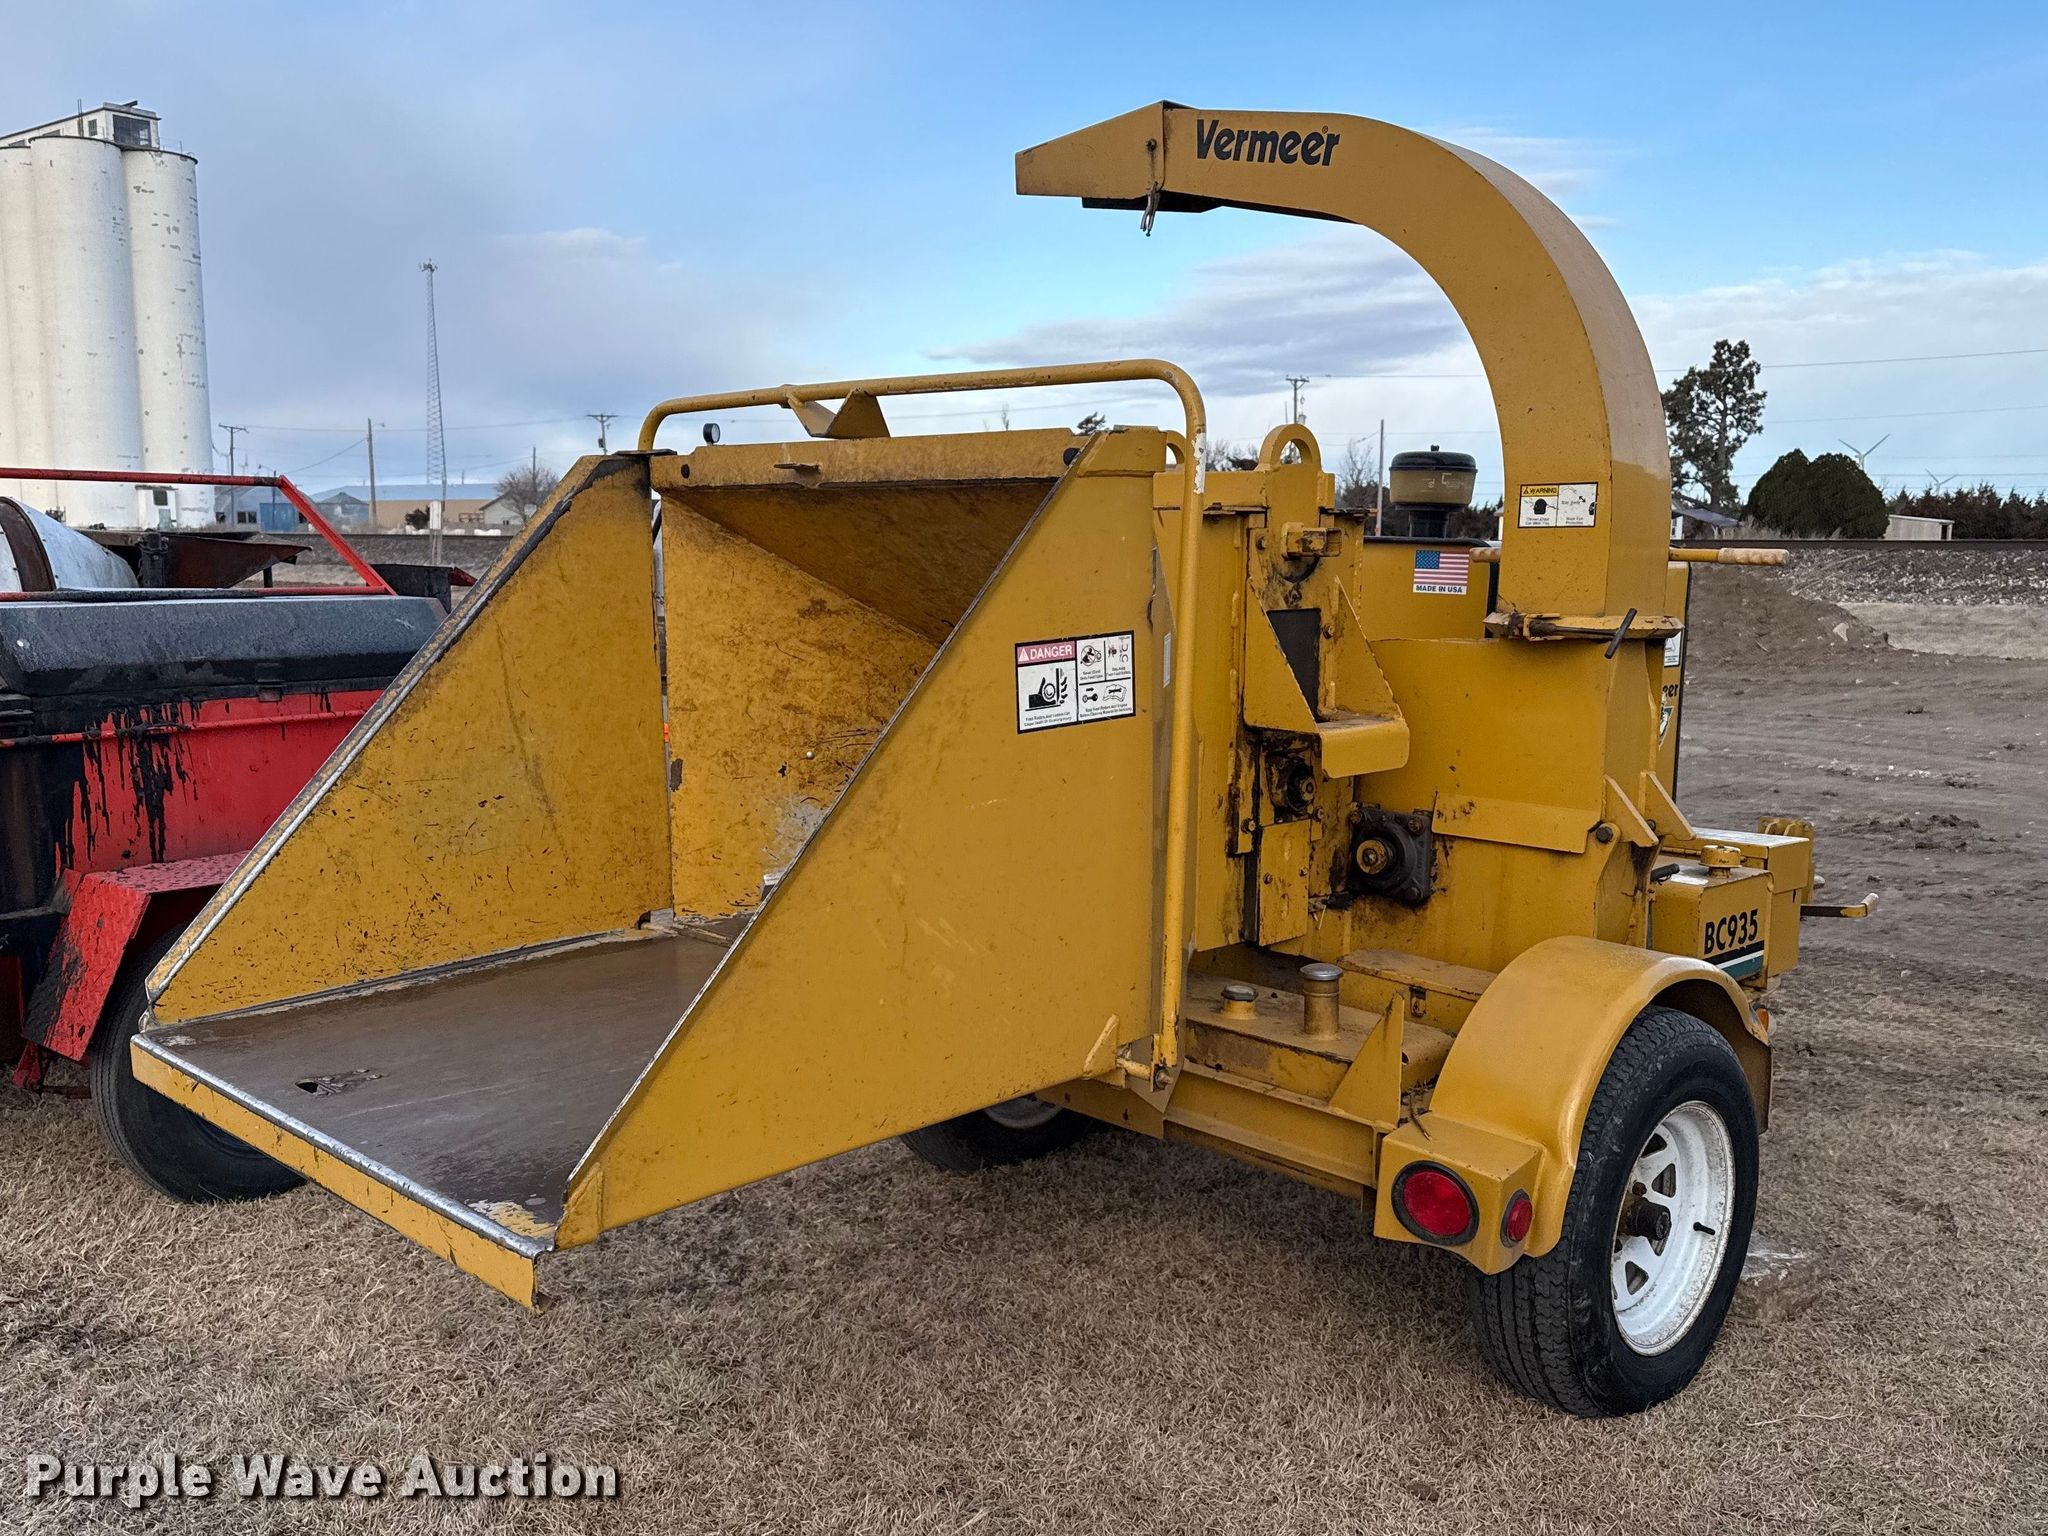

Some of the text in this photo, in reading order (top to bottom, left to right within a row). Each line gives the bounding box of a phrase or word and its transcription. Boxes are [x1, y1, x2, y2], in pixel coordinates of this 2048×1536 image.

[1197, 119, 1340, 166] Vermeer
[1030, 645, 1072, 659] DANGER
[1704, 909, 1758, 955] BC935
